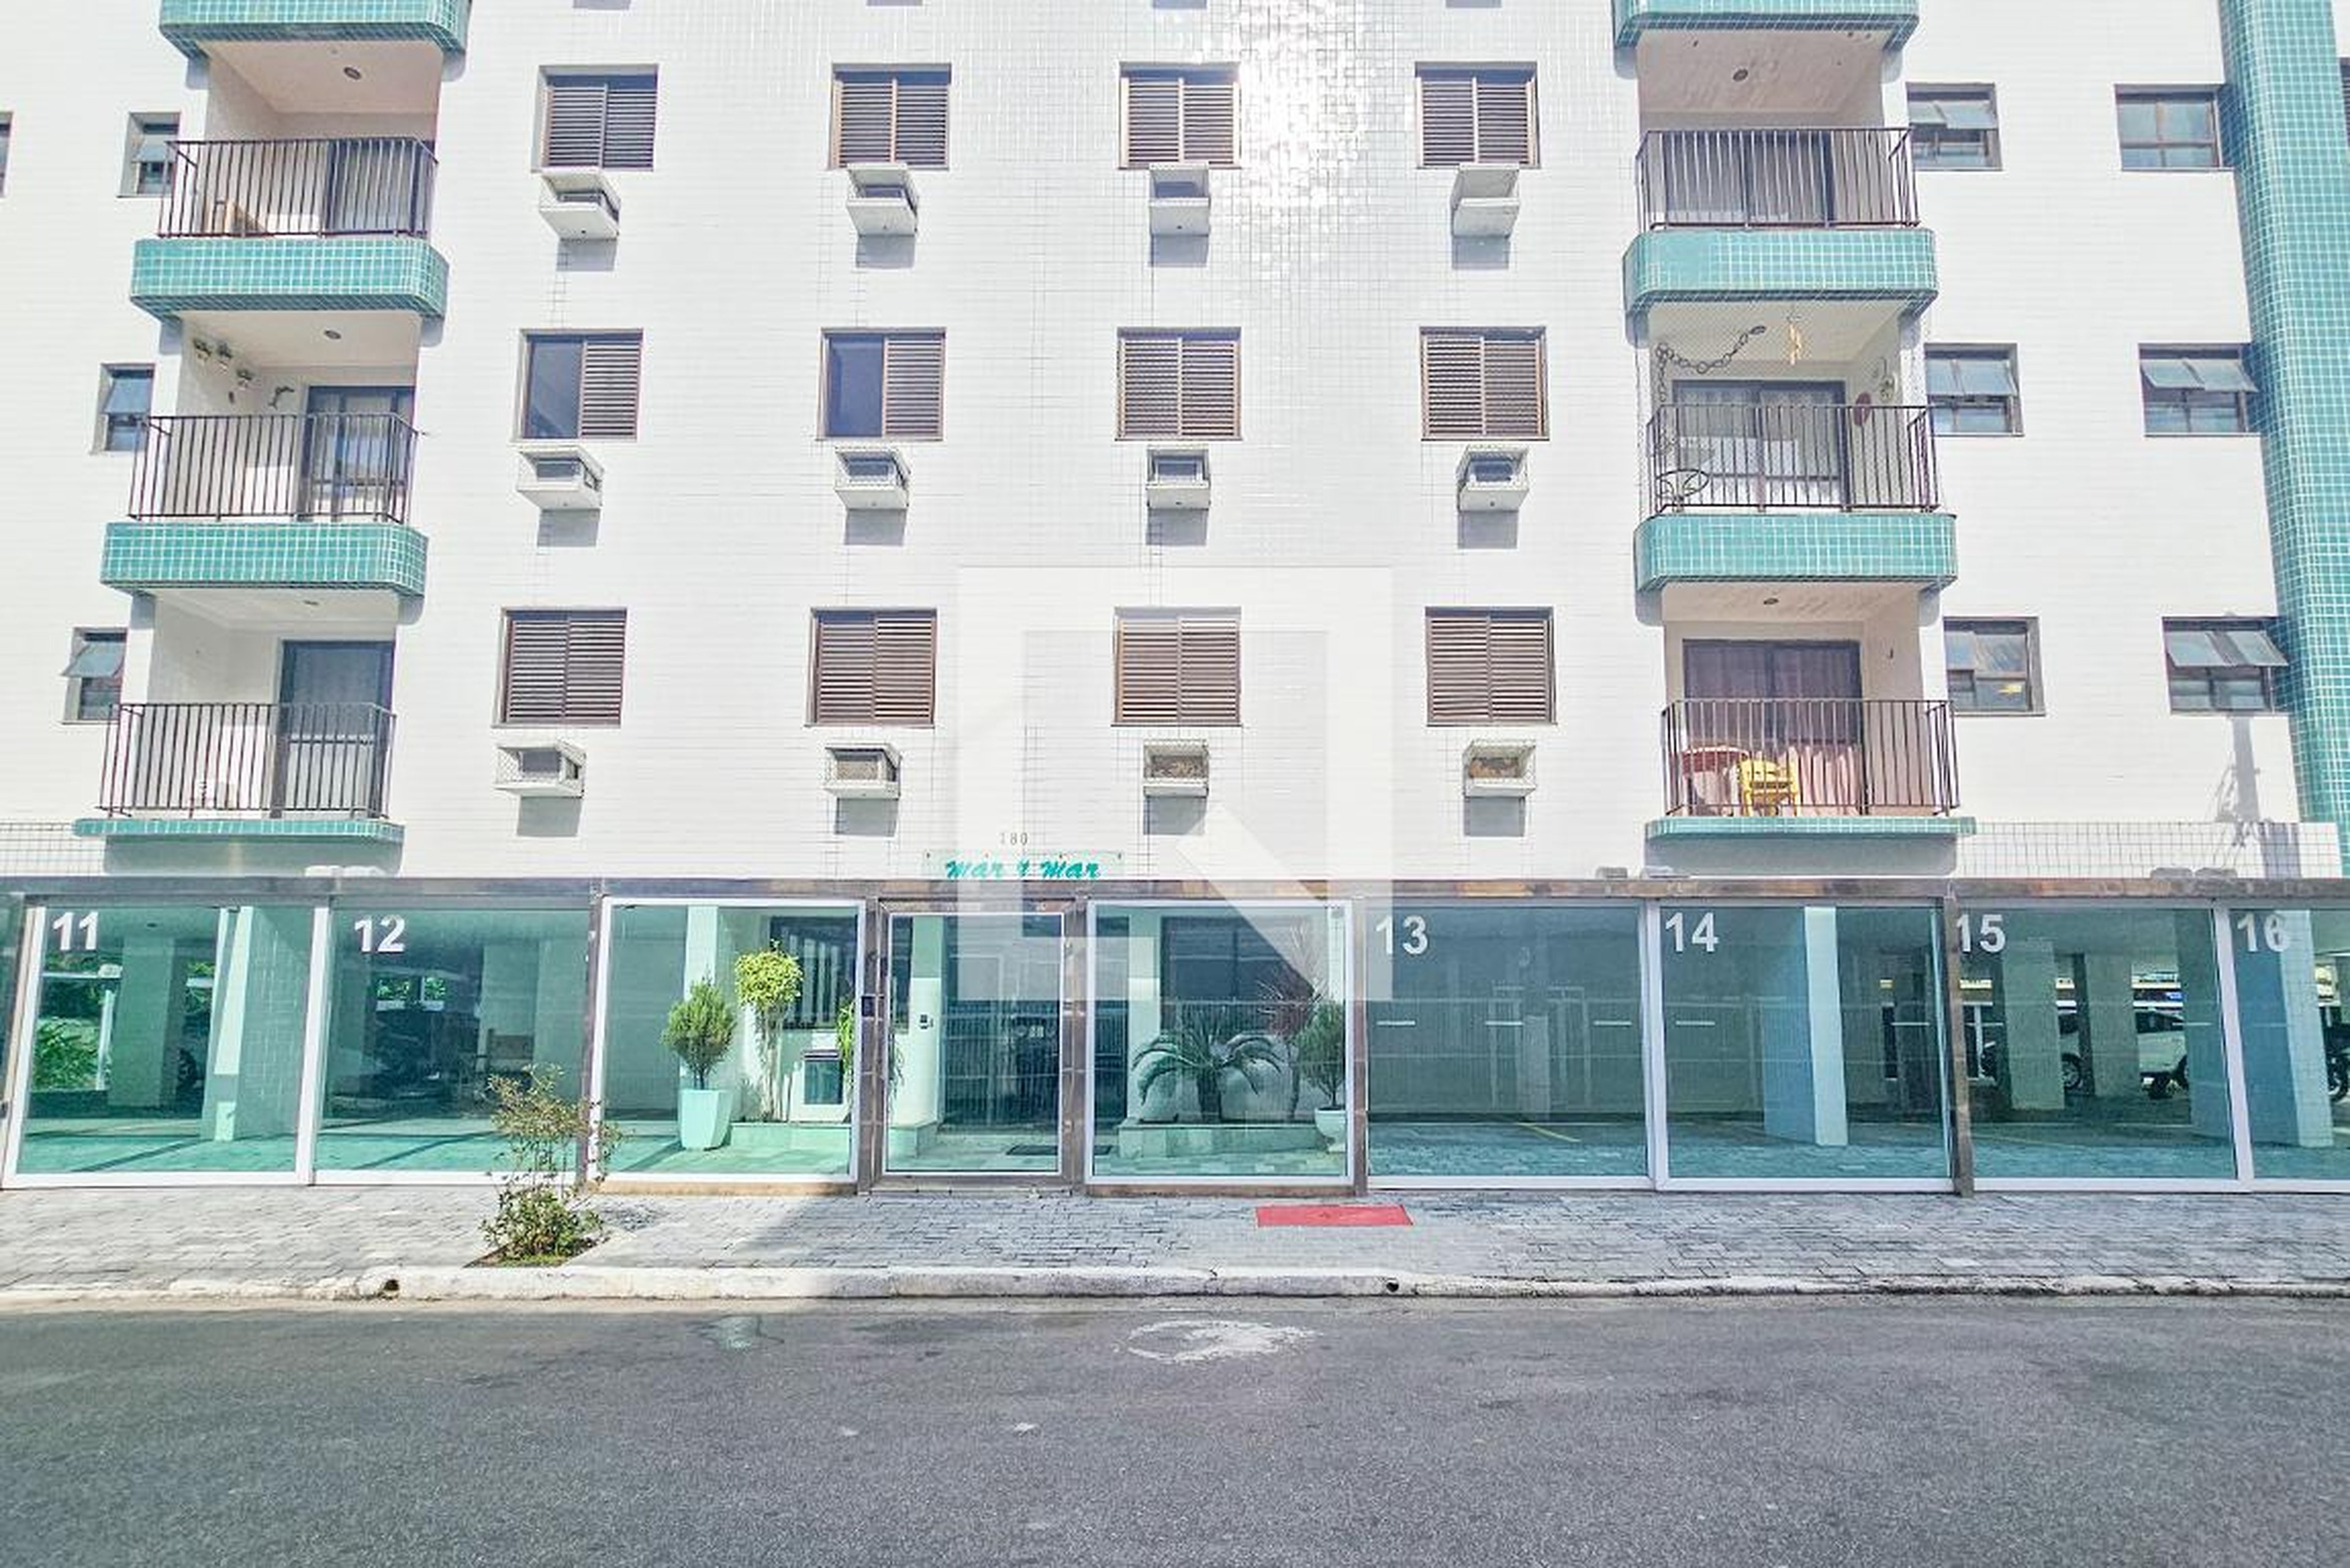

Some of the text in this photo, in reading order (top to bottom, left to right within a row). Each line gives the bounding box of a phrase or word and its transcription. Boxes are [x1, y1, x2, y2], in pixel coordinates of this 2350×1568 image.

[999, 832, 1028, 845] 180
[52, 911, 99, 951] 11
[354, 916, 406, 952] 12
[1375, 915, 1429, 955] 13
[1665, 912, 1718, 952] 14
[1956, 914, 2006, 954] 15
[2237, 913, 2291, 952] 16
